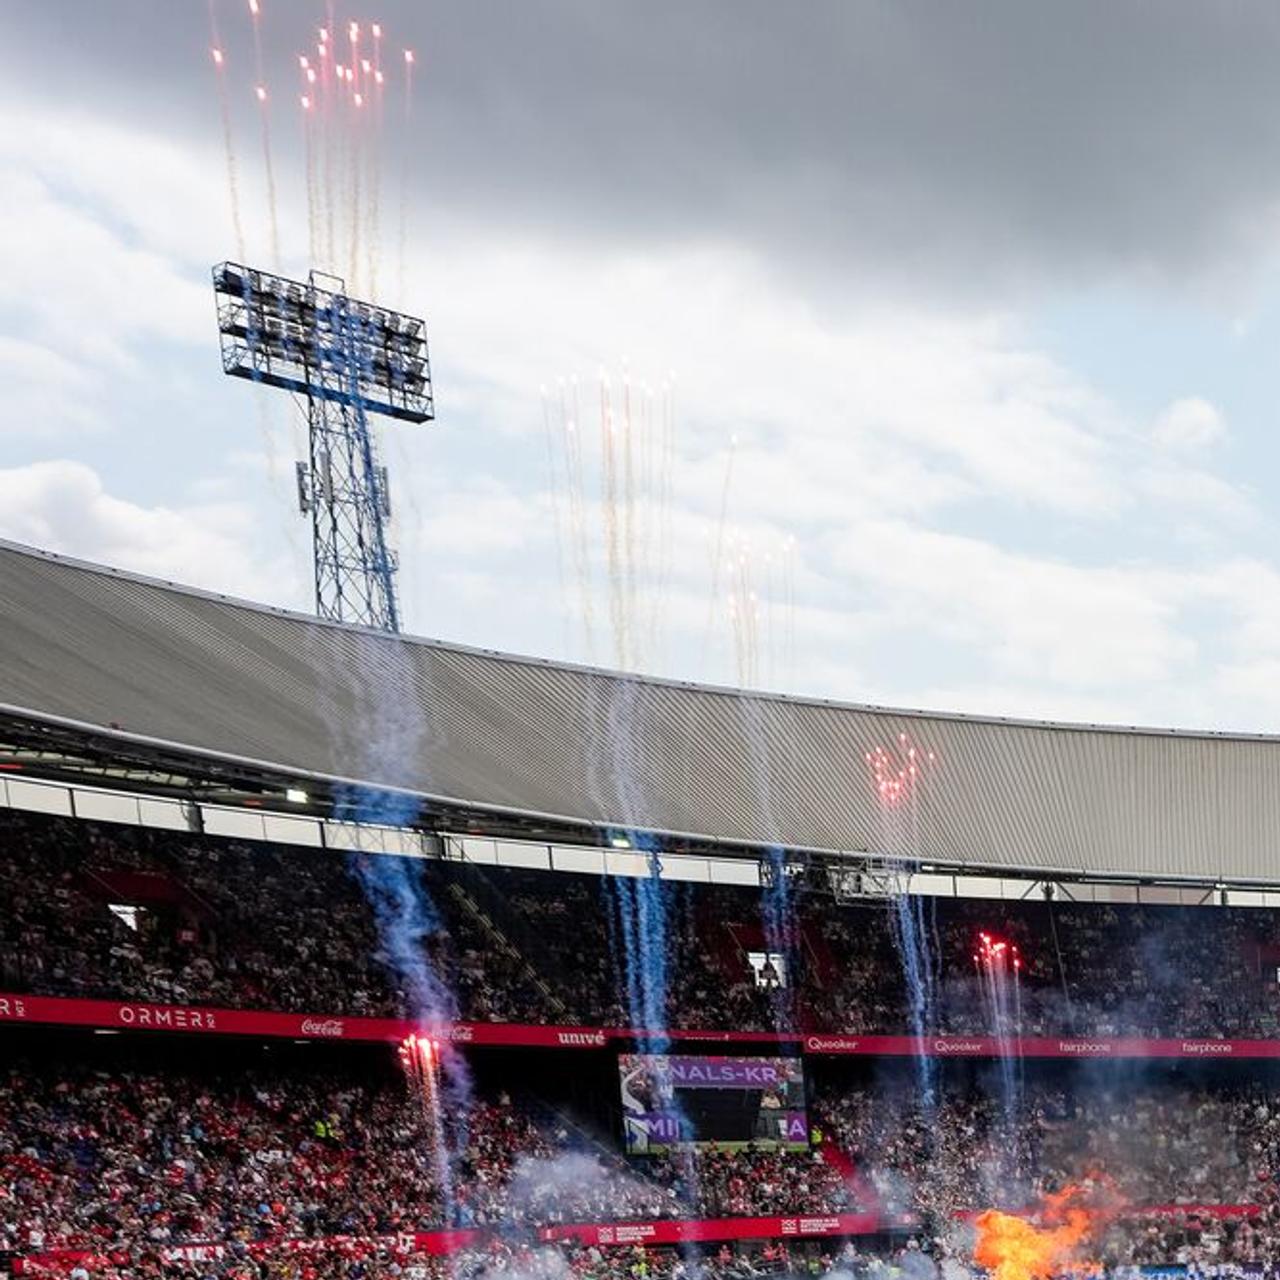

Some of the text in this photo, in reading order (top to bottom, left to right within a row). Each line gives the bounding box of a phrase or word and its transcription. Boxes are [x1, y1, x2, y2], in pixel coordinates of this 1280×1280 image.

[119, 1007, 201, 1027] ORMER
[808, 1037, 858, 1050] Quooker
[935, 1040, 982, 1052] Quooker
[1182, 1042, 1232, 1053] fairphone
